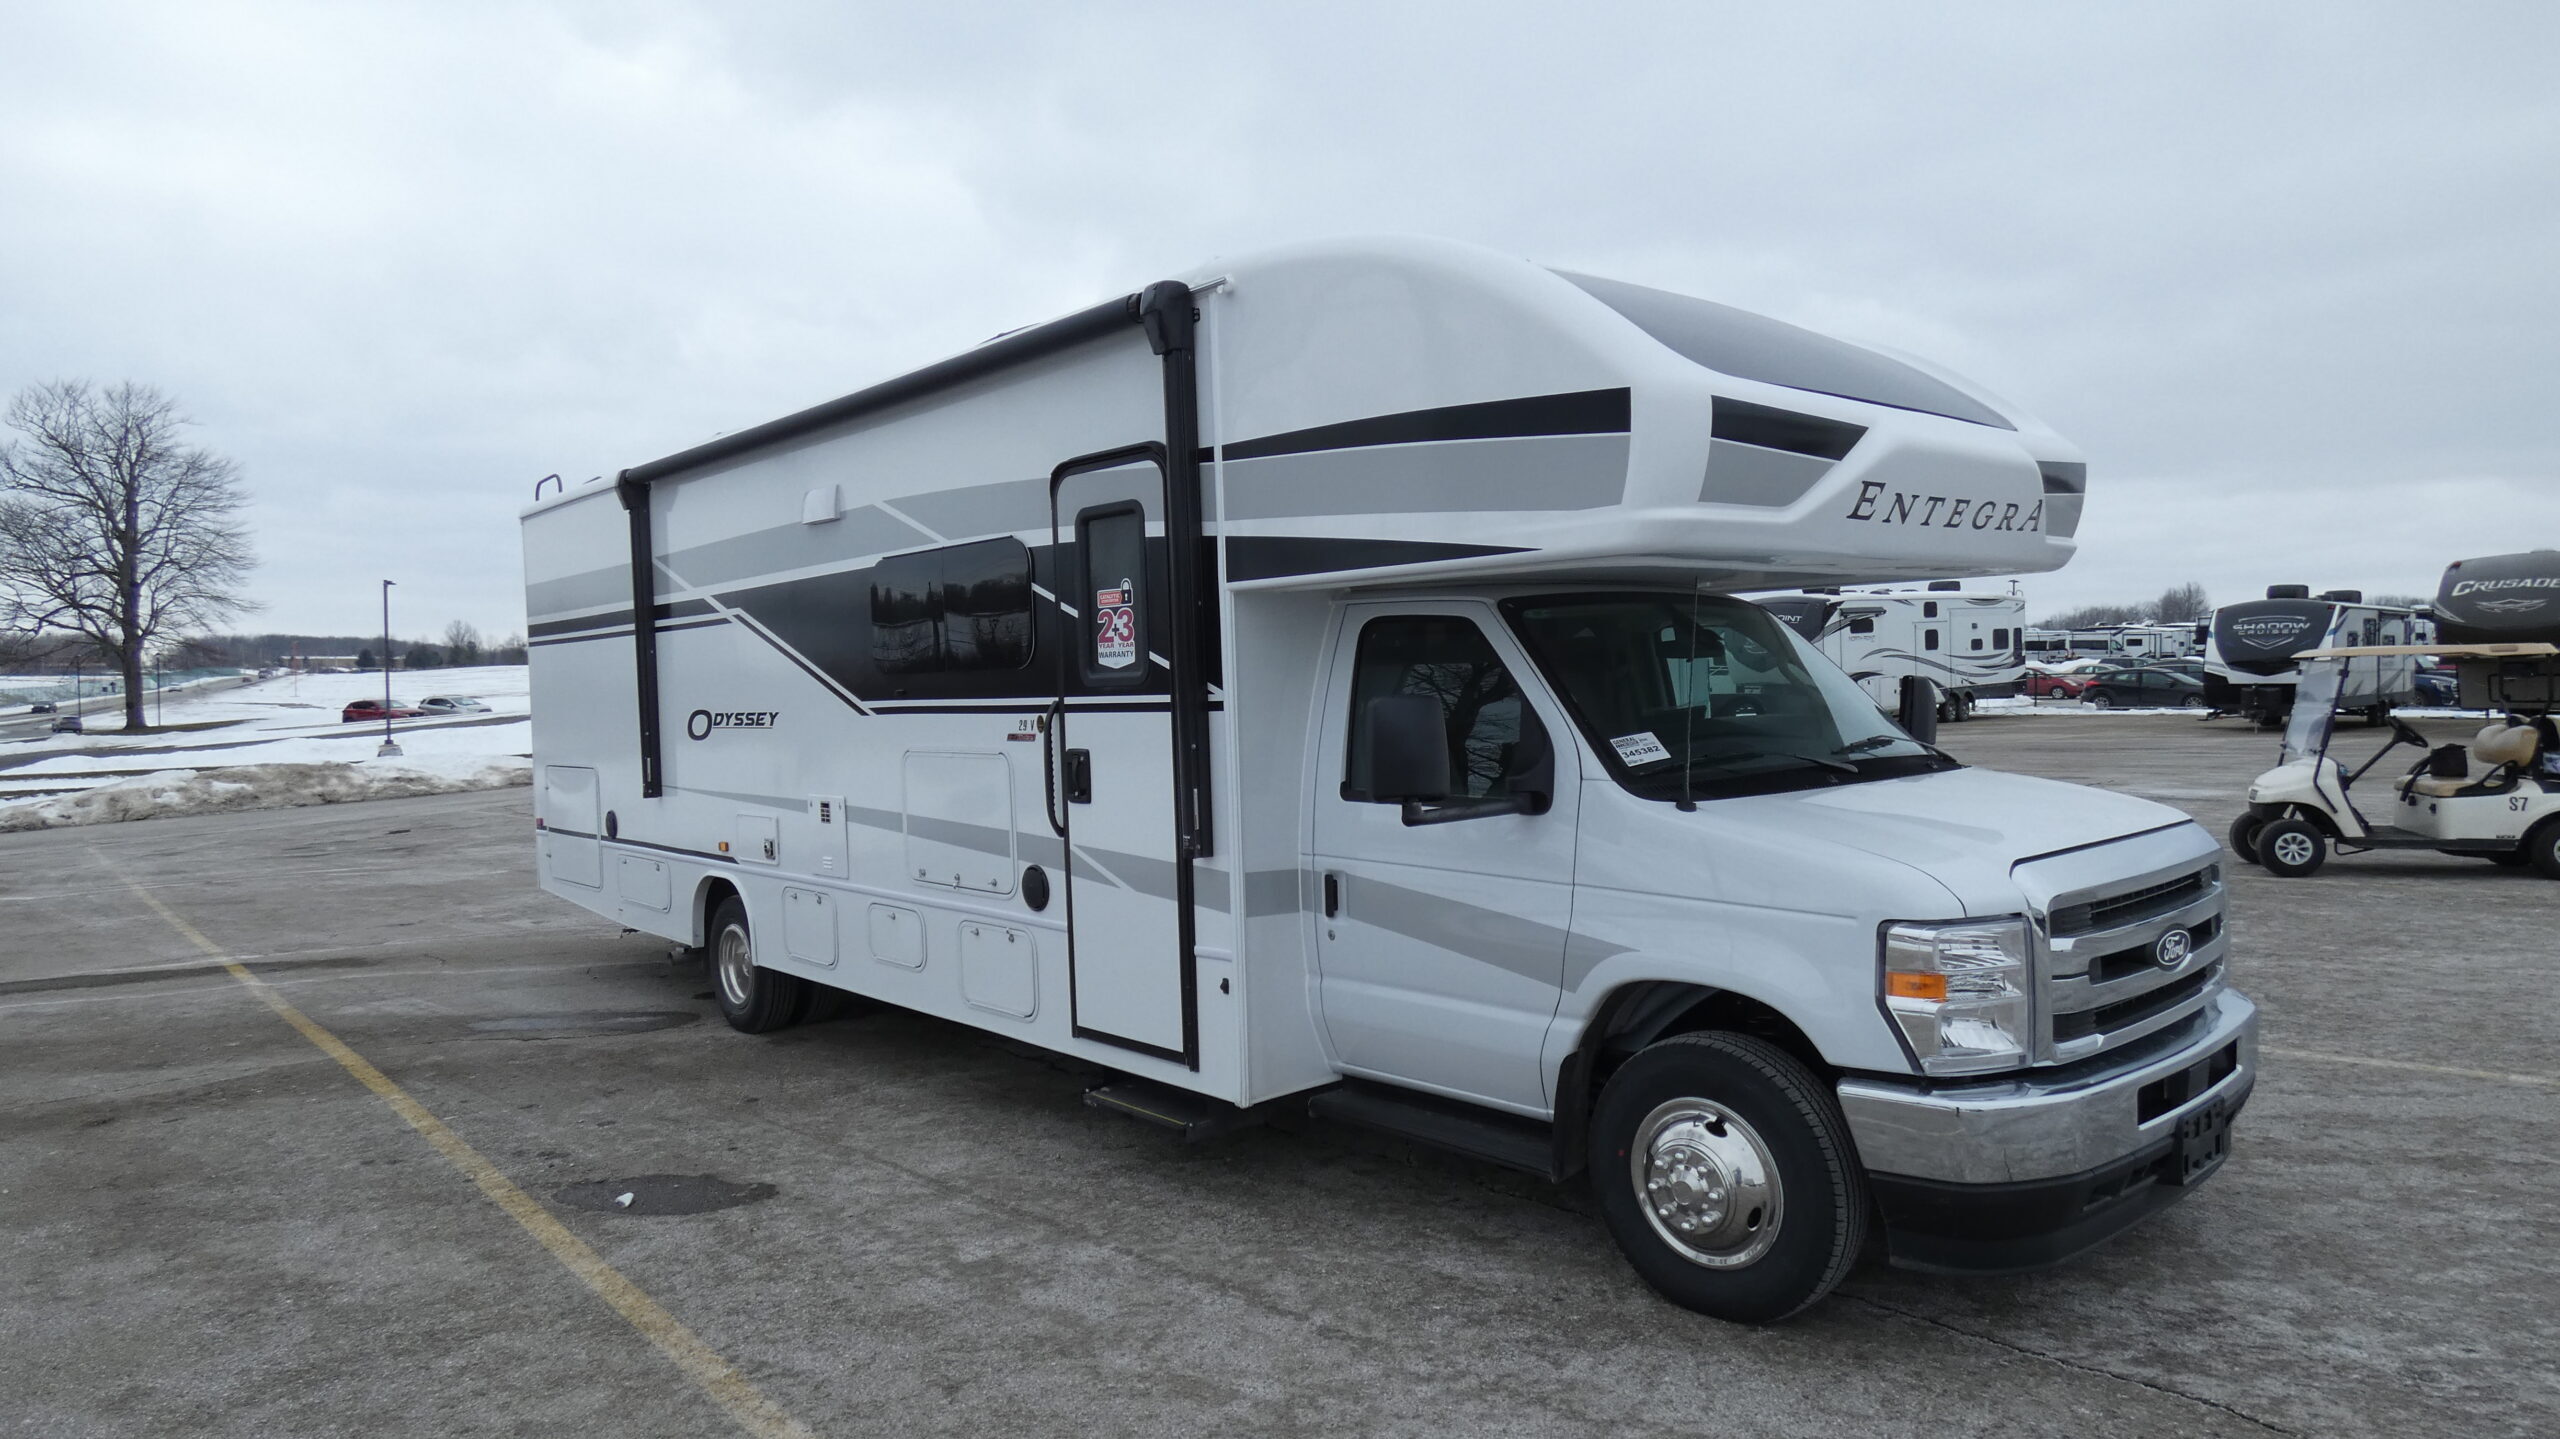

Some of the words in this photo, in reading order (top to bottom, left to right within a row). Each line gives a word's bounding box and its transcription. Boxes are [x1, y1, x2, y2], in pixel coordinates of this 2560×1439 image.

[1846, 480, 2043, 532] ENTEGRA
[2232, 622, 2311, 630] SHADOW
[1099, 650, 1134, 658] WARRANTY
[687, 709, 779, 741] ODYSSEY
[1018, 719, 1027, 731] 29
[1621, 745, 1661, 759] 345382
[2509, 796, 2529, 812] S7
[2164, 935, 2186, 961] Ford
